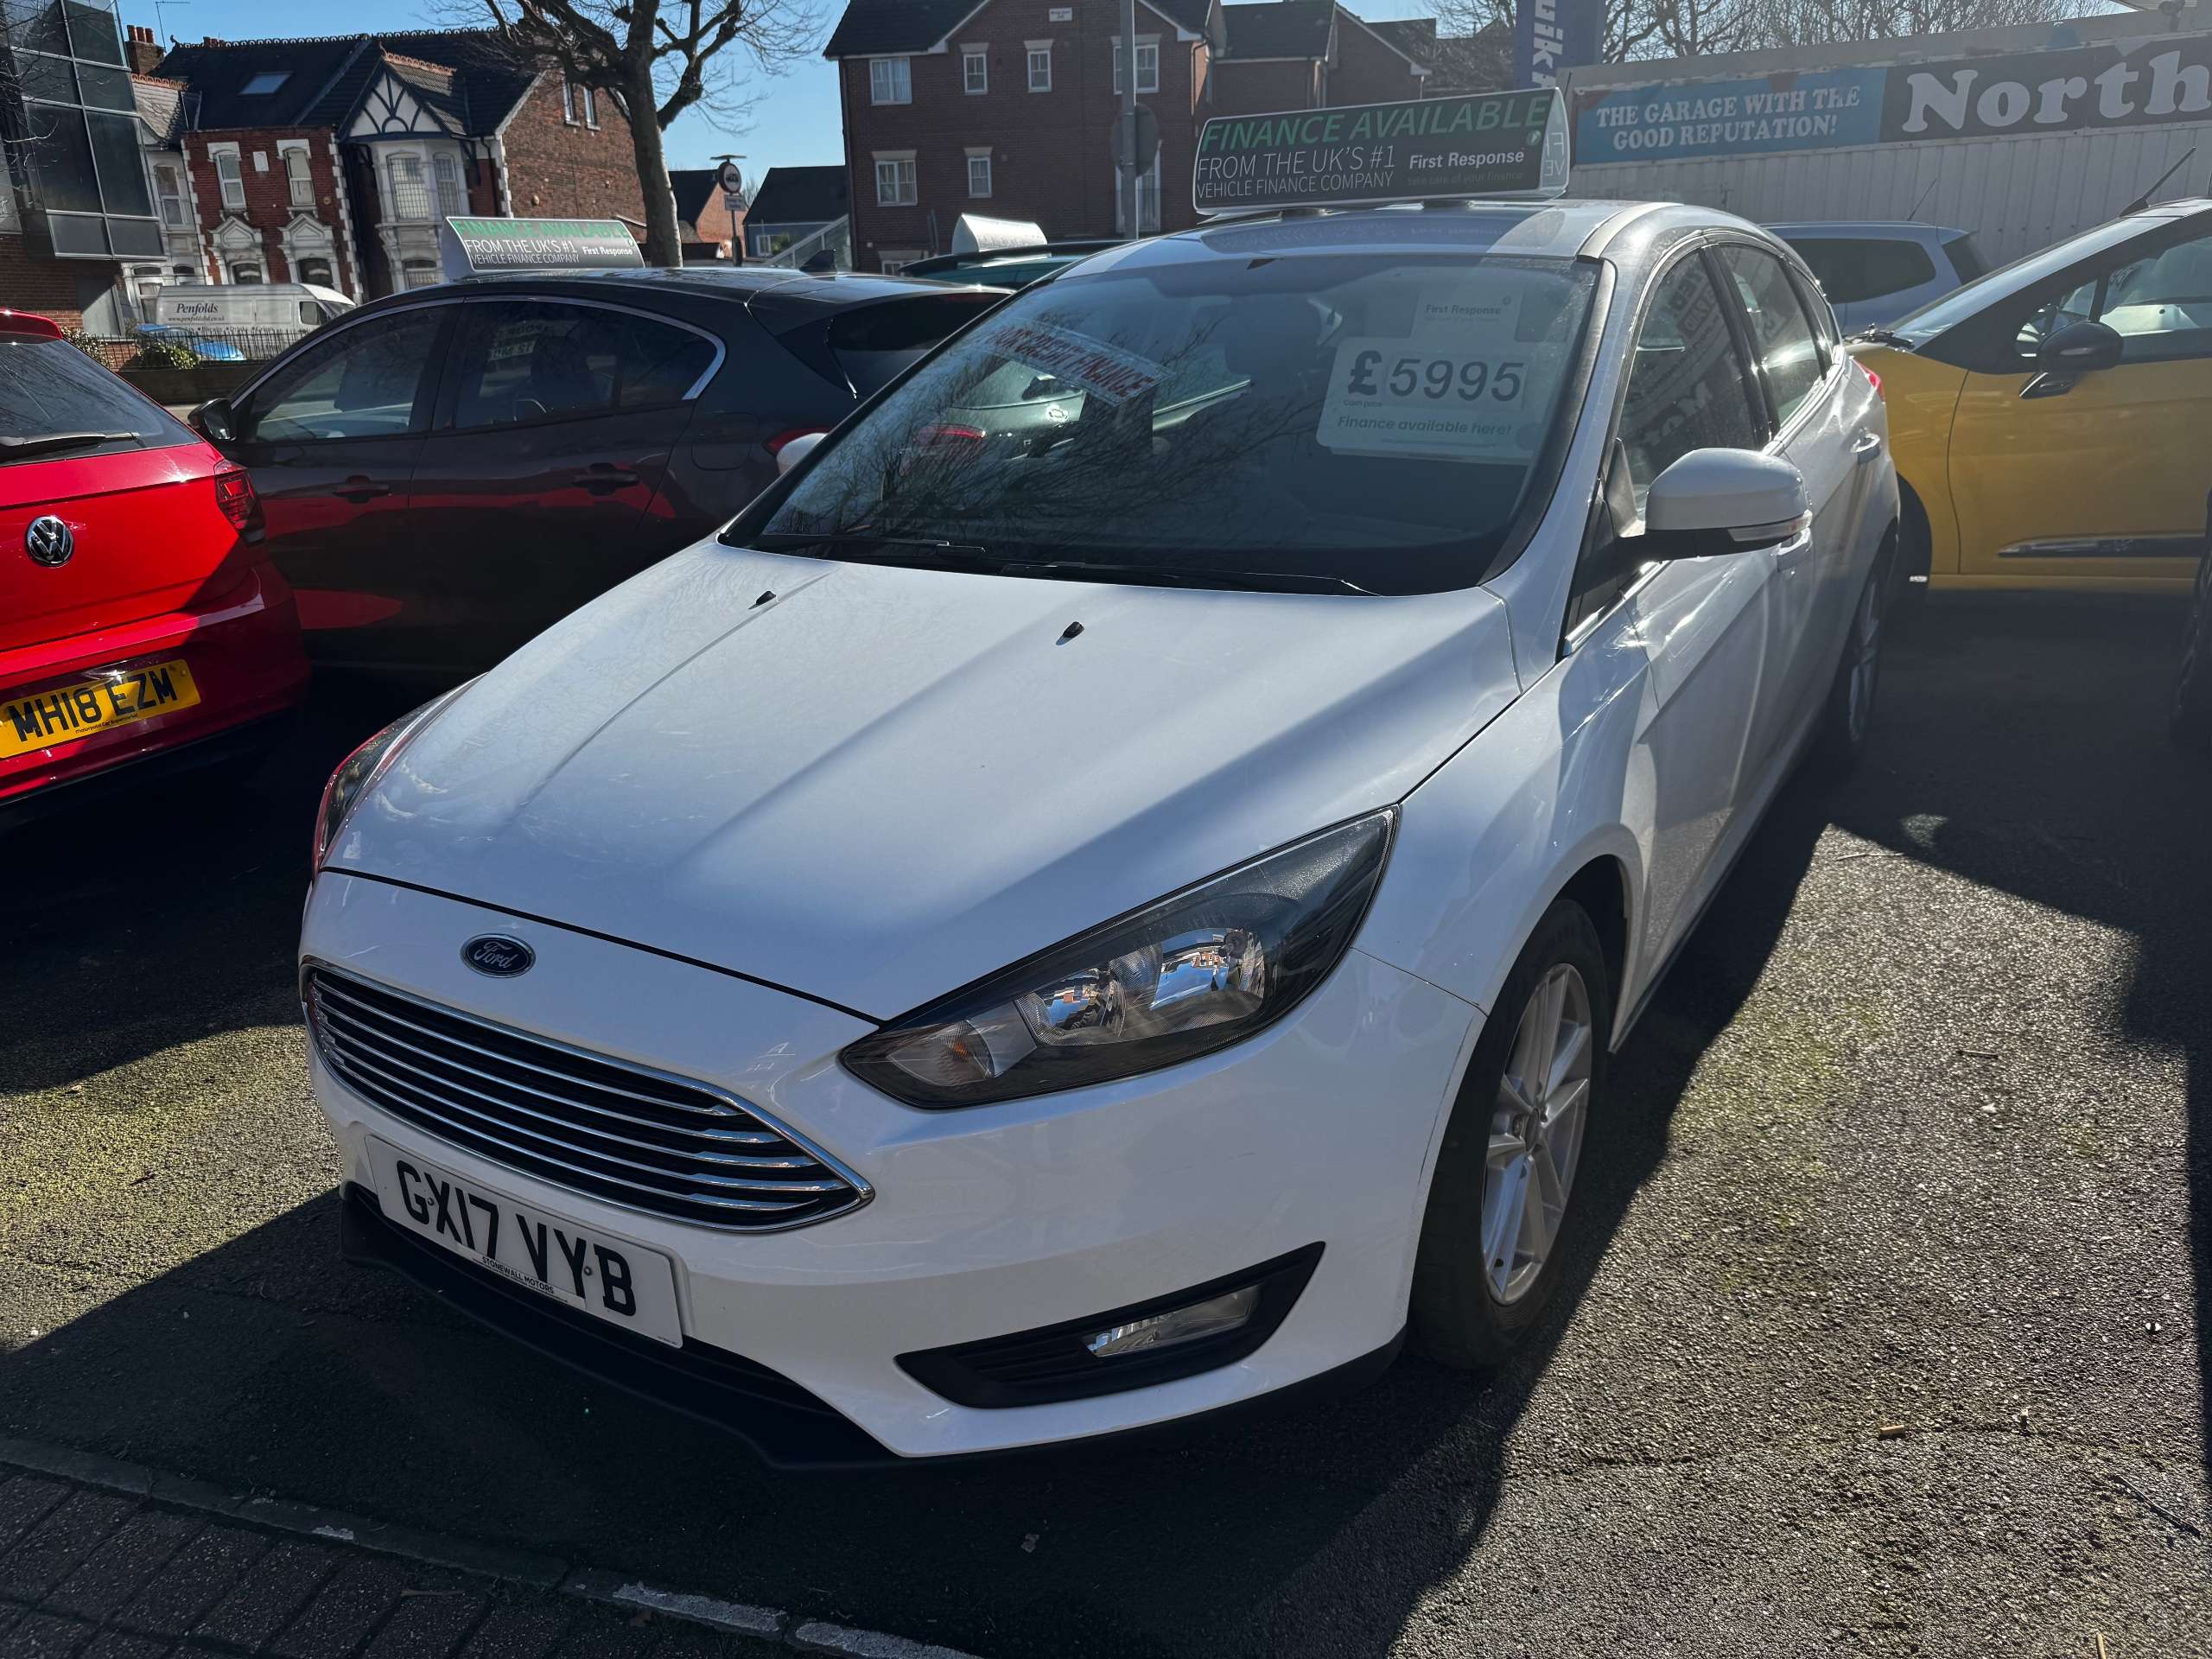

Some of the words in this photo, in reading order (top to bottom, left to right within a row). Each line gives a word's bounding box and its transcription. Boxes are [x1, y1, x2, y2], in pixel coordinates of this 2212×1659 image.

[1901, 49, 2212, 133] North
[1597, 105, 1639, 128] THE
[1643, 97, 1737, 124] GARAGE
[1745, 89, 1807, 115] WITH
[1201, 111, 1345, 153] FINANCE
[1349, 95, 1550, 141] AVAILABLE
[1613, 128, 1674, 150] GOOD
[1679, 114, 1838, 146] REPUTATION!
[1197, 154, 1256, 181] FROM
[1263, 150, 1306, 176] THE
[1313, 146, 1364, 173] UK'S
[1370, 144, 1395, 169] #1
[1409, 155, 1443, 169] First
[1448, 151, 1524, 168] Response
[1197, 179, 1252, 200] VEHICLE
[1256, 175, 1318, 194] FINANCE
[1321, 170, 1395, 191] COMPANY
[454, 220, 534, 238] FINANCE
[538, 221, 632, 239] AVAILABLE
[465, 239, 502, 253] FROM
[503, 239, 531, 253] THE
[531, 239, 561, 253] UK'S
[562, 240, 577, 253] #1
[472, 254, 507, 264] VEHICLE
[507, 254, 543, 264] FINANCE
[543, 253, 580, 264] COMPANY
[582, 246, 600, 256] First
[601, 247, 633, 257] Response
[176, 302, 219, 315] Penfolds
[1426, 303, 1448, 315] First
[1451, 304, 1501, 318] Response
[1348, 350, 1527, 402] £5995
[1338, 416, 1395, 430] Finance
[1398, 419, 1468, 434] available
[1471, 422, 1512, 435] here!
[8, 690, 102, 743] MH18
[105, 667, 178, 716] EZM
[474, 941, 519, 969] Ford
[396, 1160, 499, 1262] GX17
[515, 1213, 637, 1317] VYB
[482, 1255, 524, 1281] STONEWALL
[524, 1274, 555, 1294] MOTORS
